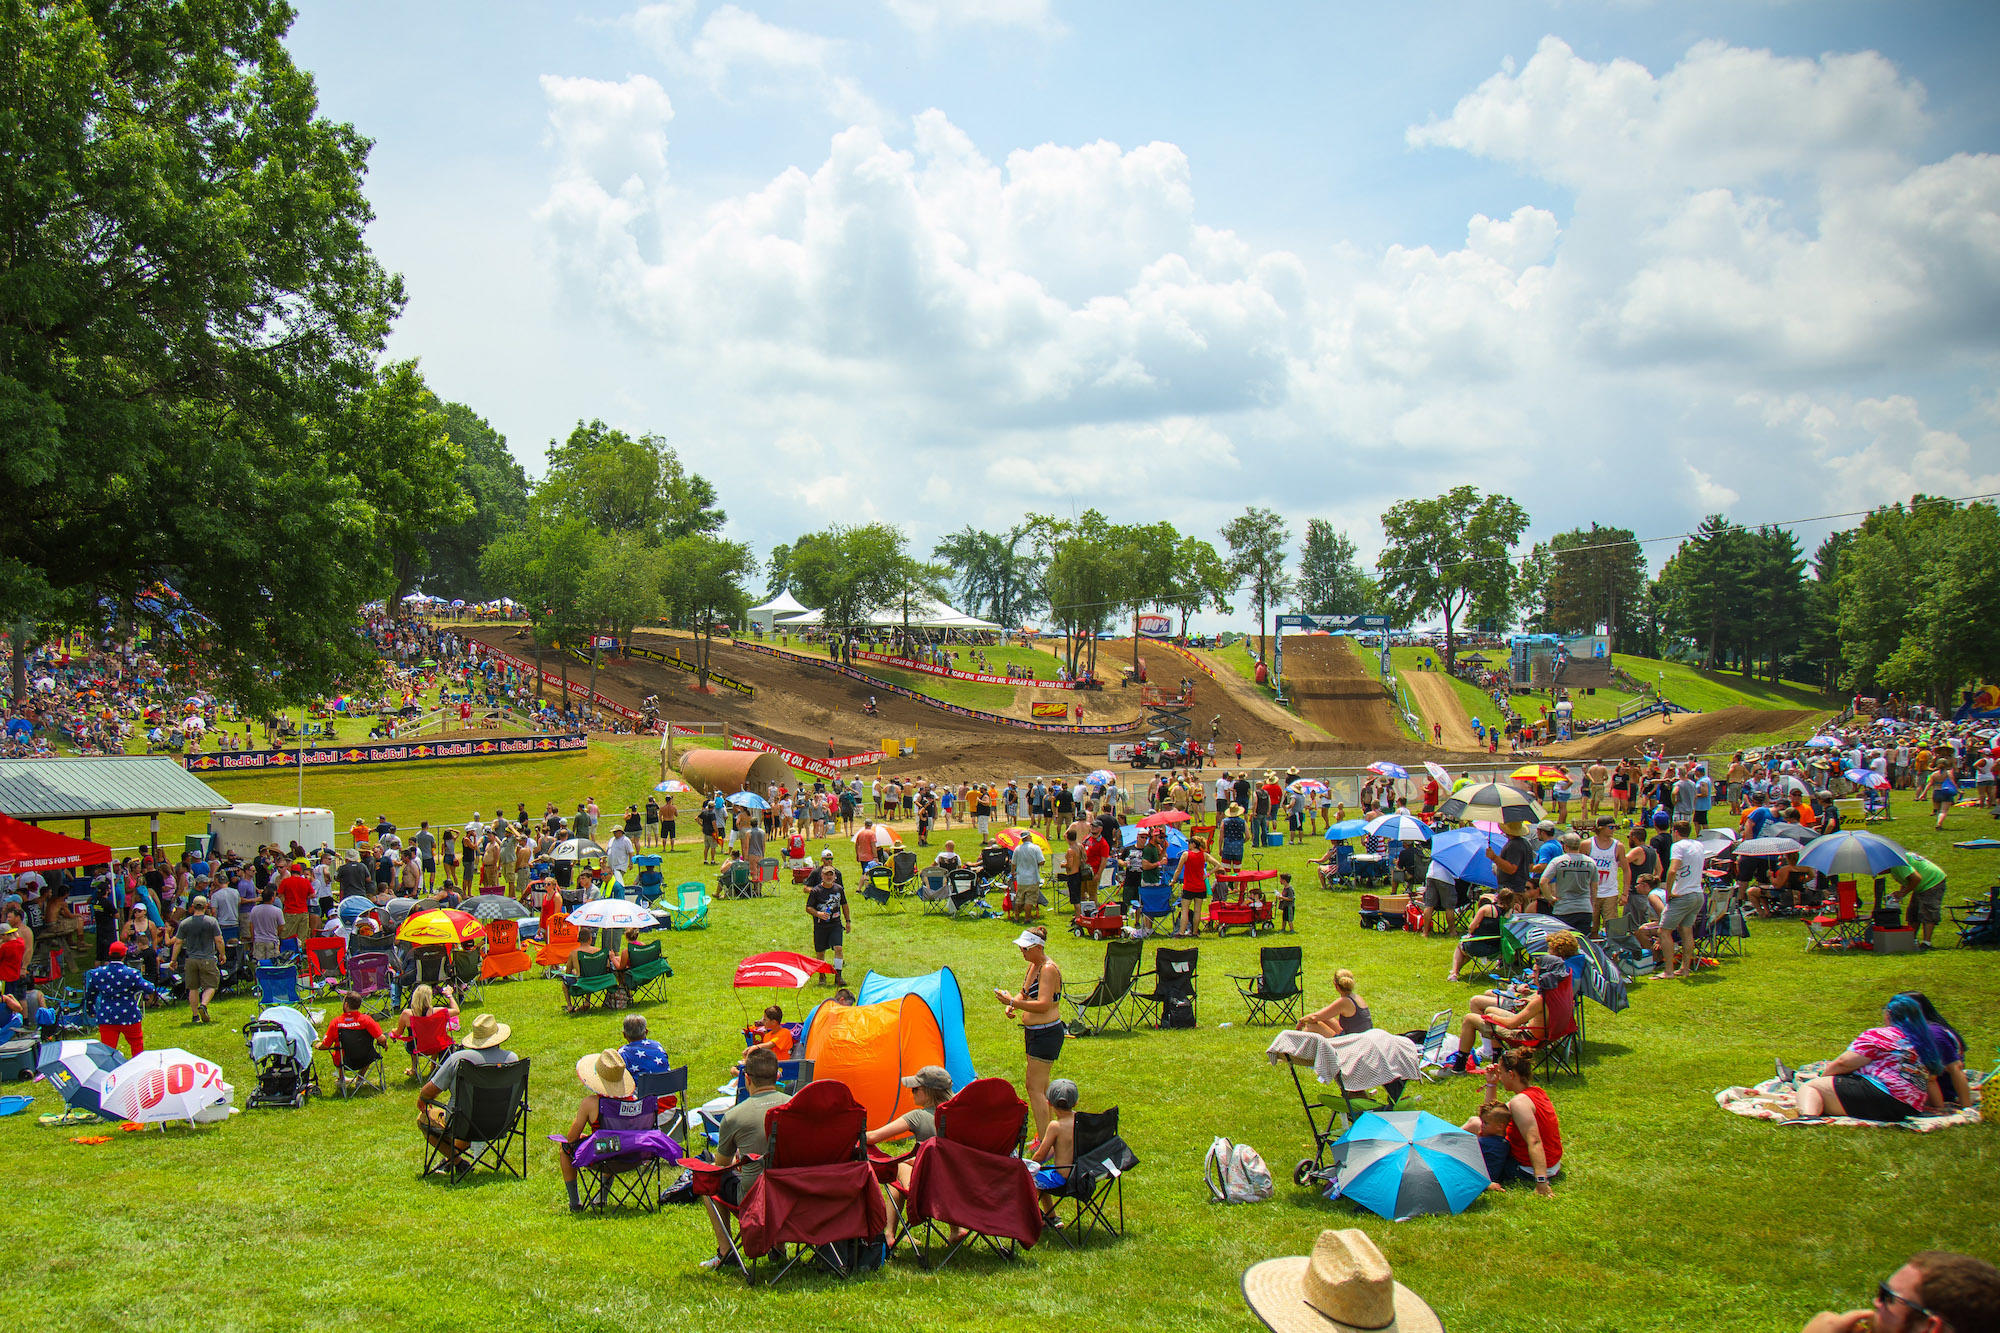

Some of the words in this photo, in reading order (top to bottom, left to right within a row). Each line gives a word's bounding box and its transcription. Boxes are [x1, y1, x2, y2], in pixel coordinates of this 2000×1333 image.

[1140, 618, 1168, 632] 100%
[889, 657, 906, 665] LUCAS
[916, 662, 934, 671] LUCAS
[934, 666, 944, 674] OIL
[572, 685, 590, 696] LUCAS
[600, 698, 614, 709] LUCAS
[615, 706, 623, 714] OIL
[791, 756, 803, 767] OIL
[806, 760, 830, 775] LUCAS
[850, 755, 863, 765] LUCAS
[78, 904, 91, 914] WE
[491, 922, 513, 931] READY
